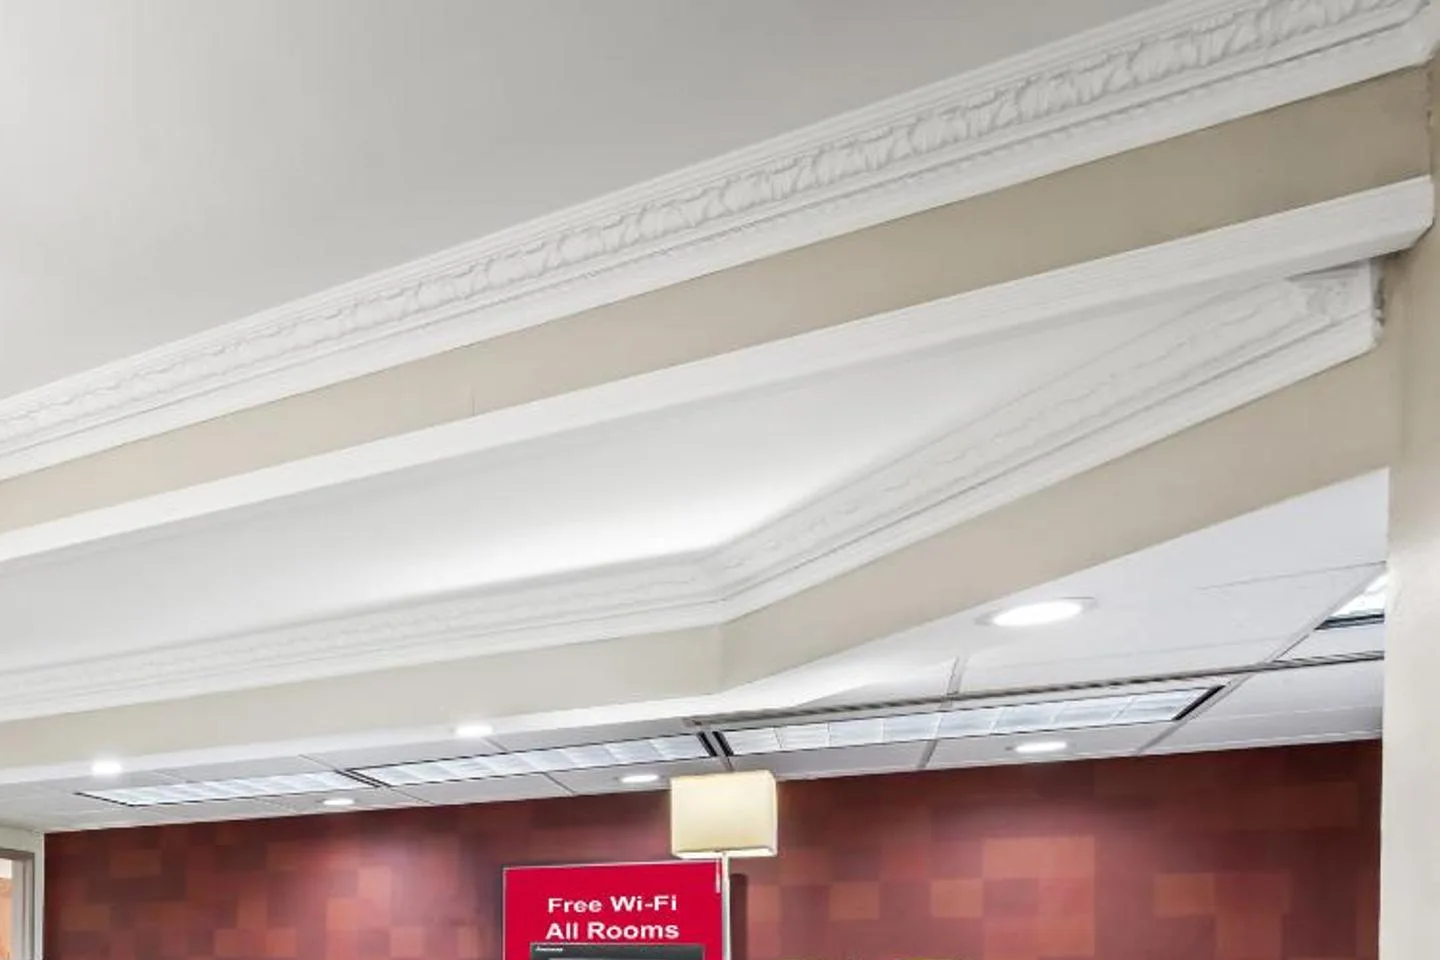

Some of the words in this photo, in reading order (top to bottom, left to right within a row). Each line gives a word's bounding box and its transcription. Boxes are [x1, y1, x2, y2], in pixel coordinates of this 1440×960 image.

[547, 897, 602, 913] Free
[610, 895, 677, 912] Wi-Fi
[545, 922, 579, 940] All
[587, 921, 680, 940] Rooms
